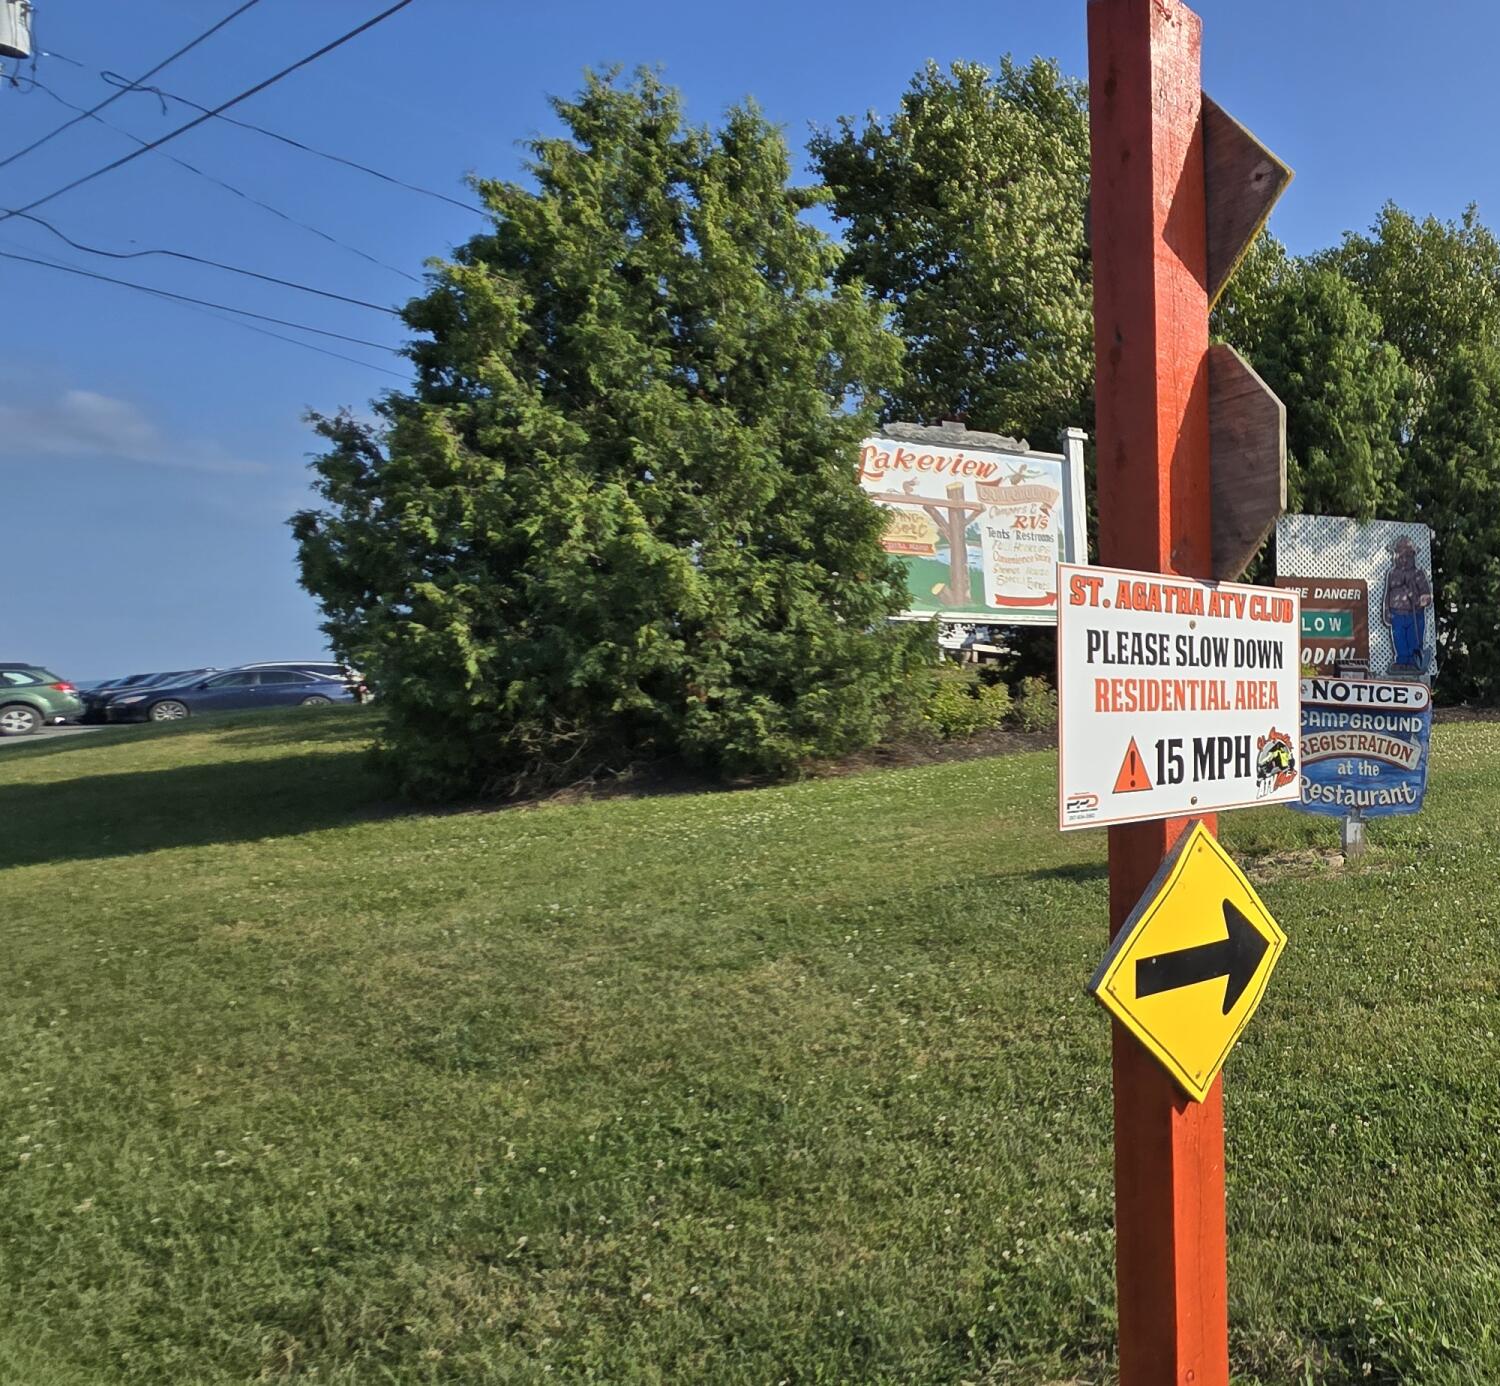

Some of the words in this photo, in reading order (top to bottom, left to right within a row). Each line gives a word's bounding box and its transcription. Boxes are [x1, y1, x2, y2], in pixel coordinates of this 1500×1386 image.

[858, 445, 998, 481] Lakeview
[986, 527, 1010, 539] Tents
[1016, 530, 1055, 542] Restrooms
[1069, 574, 1111, 608] ST.
[1115, 579, 1204, 616] AGATHA
[1208, 591, 1248, 619] ATV
[1250, 595, 1294, 623] CLUB
[1314, 587, 1361, 600] DANGER
[1302, 617, 1342, 631] LOW
[1086, 629, 1170, 666] PLEASE
[1176, 635, 1230, 668] SLOW
[1234, 638, 1283, 669] DOWN
[1301, 647, 1356, 665] ODAY!
[1094, 678, 1231, 712] RESIDENTIAL
[1235, 680, 1279, 710] AREA
[1311, 680, 1409, 704] NOTICE
[1300, 710, 1423, 733] CAMPGROUND
[1155, 738, 1185, 785] 15
[1193, 735, 1251, 782] MPH
[1300, 734, 1414, 763] REGISTRATION
[1337, 760, 1354, 775] at
[1358, 760, 1380, 776] the
[1300, 775, 1417, 806] Restaurant
